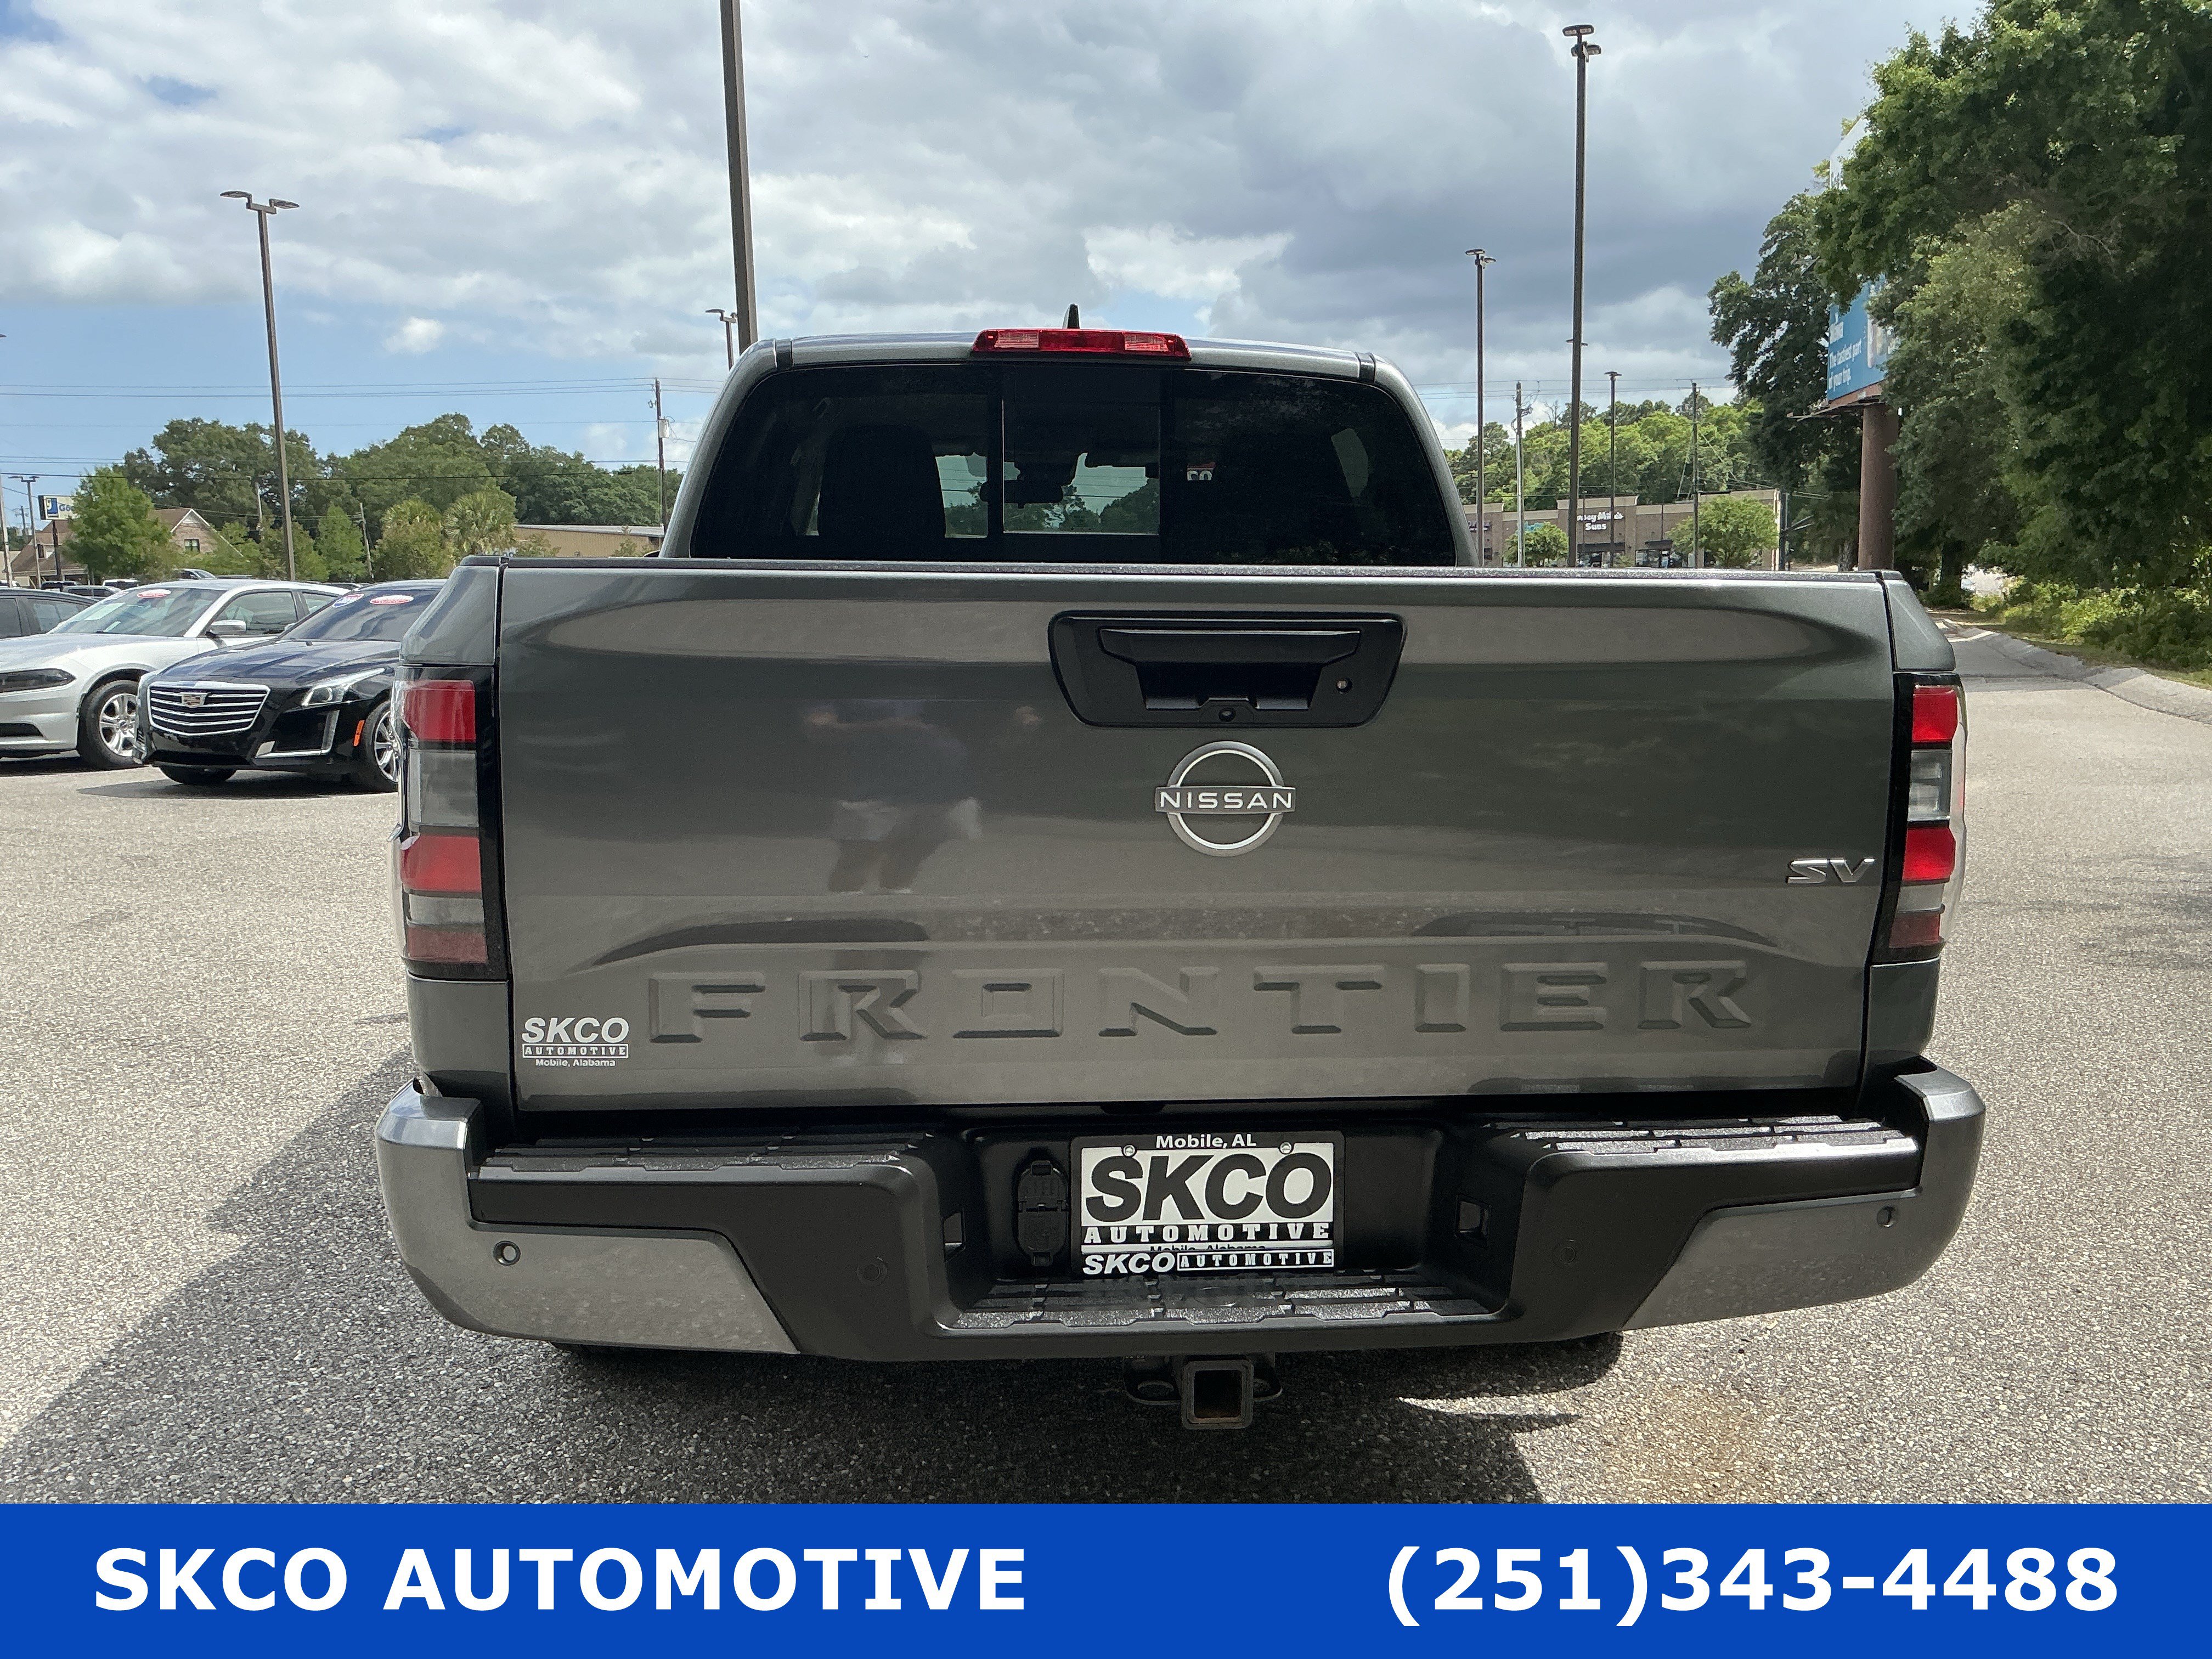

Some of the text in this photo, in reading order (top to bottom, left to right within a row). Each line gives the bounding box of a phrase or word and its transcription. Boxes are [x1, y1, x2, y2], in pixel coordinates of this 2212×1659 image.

[1585, 522, 1607, 531] Subs
[1160, 791, 1292, 809] NISSAN
[1785, 857, 1876, 884] SV
[648, 960, 1752, 1043] FRONTIER
[521, 1017, 629, 1043] SKCO
[524, 1046, 627, 1056] AUTOMOTIVE
[535, 1059, 571, 1067] Mobile,
[1155, 1133, 1257, 1149] Mobile, AL
[1085, 1152, 1332, 1222] SKCO
[1084, 1222, 1329, 1244] AUTOMOTIVE
[1082, 1252, 1333, 1274] SKCO AUTOMOTIVE
